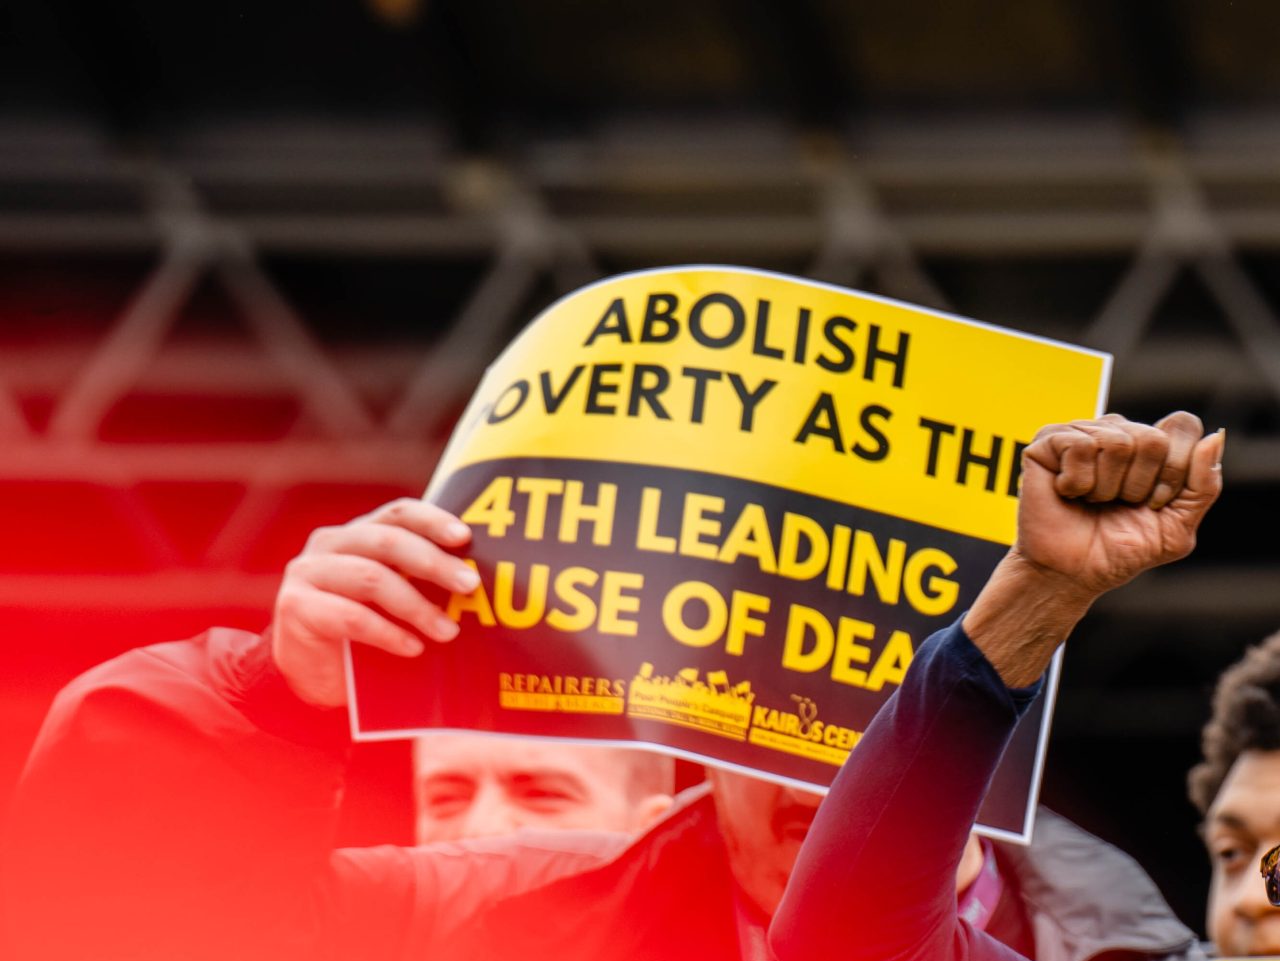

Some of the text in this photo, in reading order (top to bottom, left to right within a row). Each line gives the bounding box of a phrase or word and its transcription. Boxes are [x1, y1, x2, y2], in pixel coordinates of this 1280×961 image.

[584, 292, 911, 390] ABOLISH
[476, 363, 778, 434] OVERTY
[795, 392, 890, 462] AS
[461, 476, 959, 615] 4TH LEADING
[446, 560, 914, 693] AUSE OF DEA
[500, 672, 626, 697] REPAIRERS
